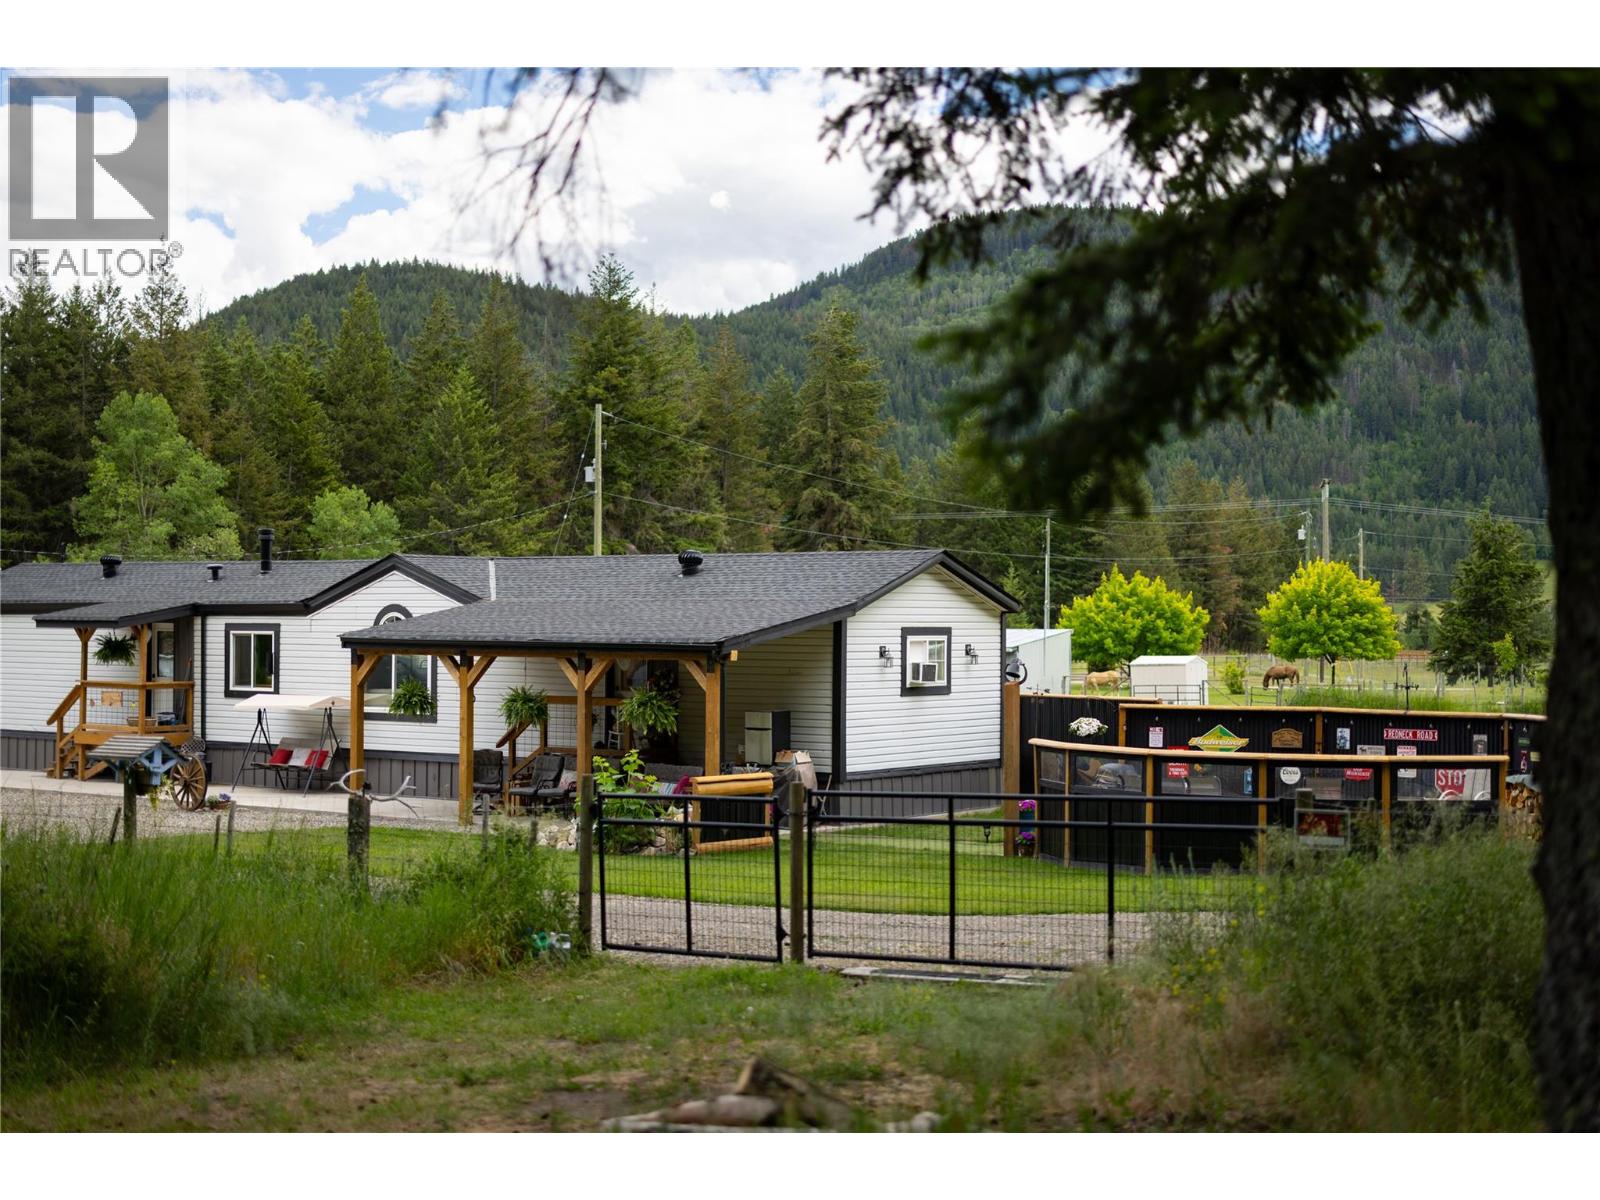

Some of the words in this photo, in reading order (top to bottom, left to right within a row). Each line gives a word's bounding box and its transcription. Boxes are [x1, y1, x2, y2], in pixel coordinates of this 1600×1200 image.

[1387, 730, 1413, 740] REDNECK
[1416, 730, 1434, 740] ROAD
[1437, 769, 1465, 787] STO
